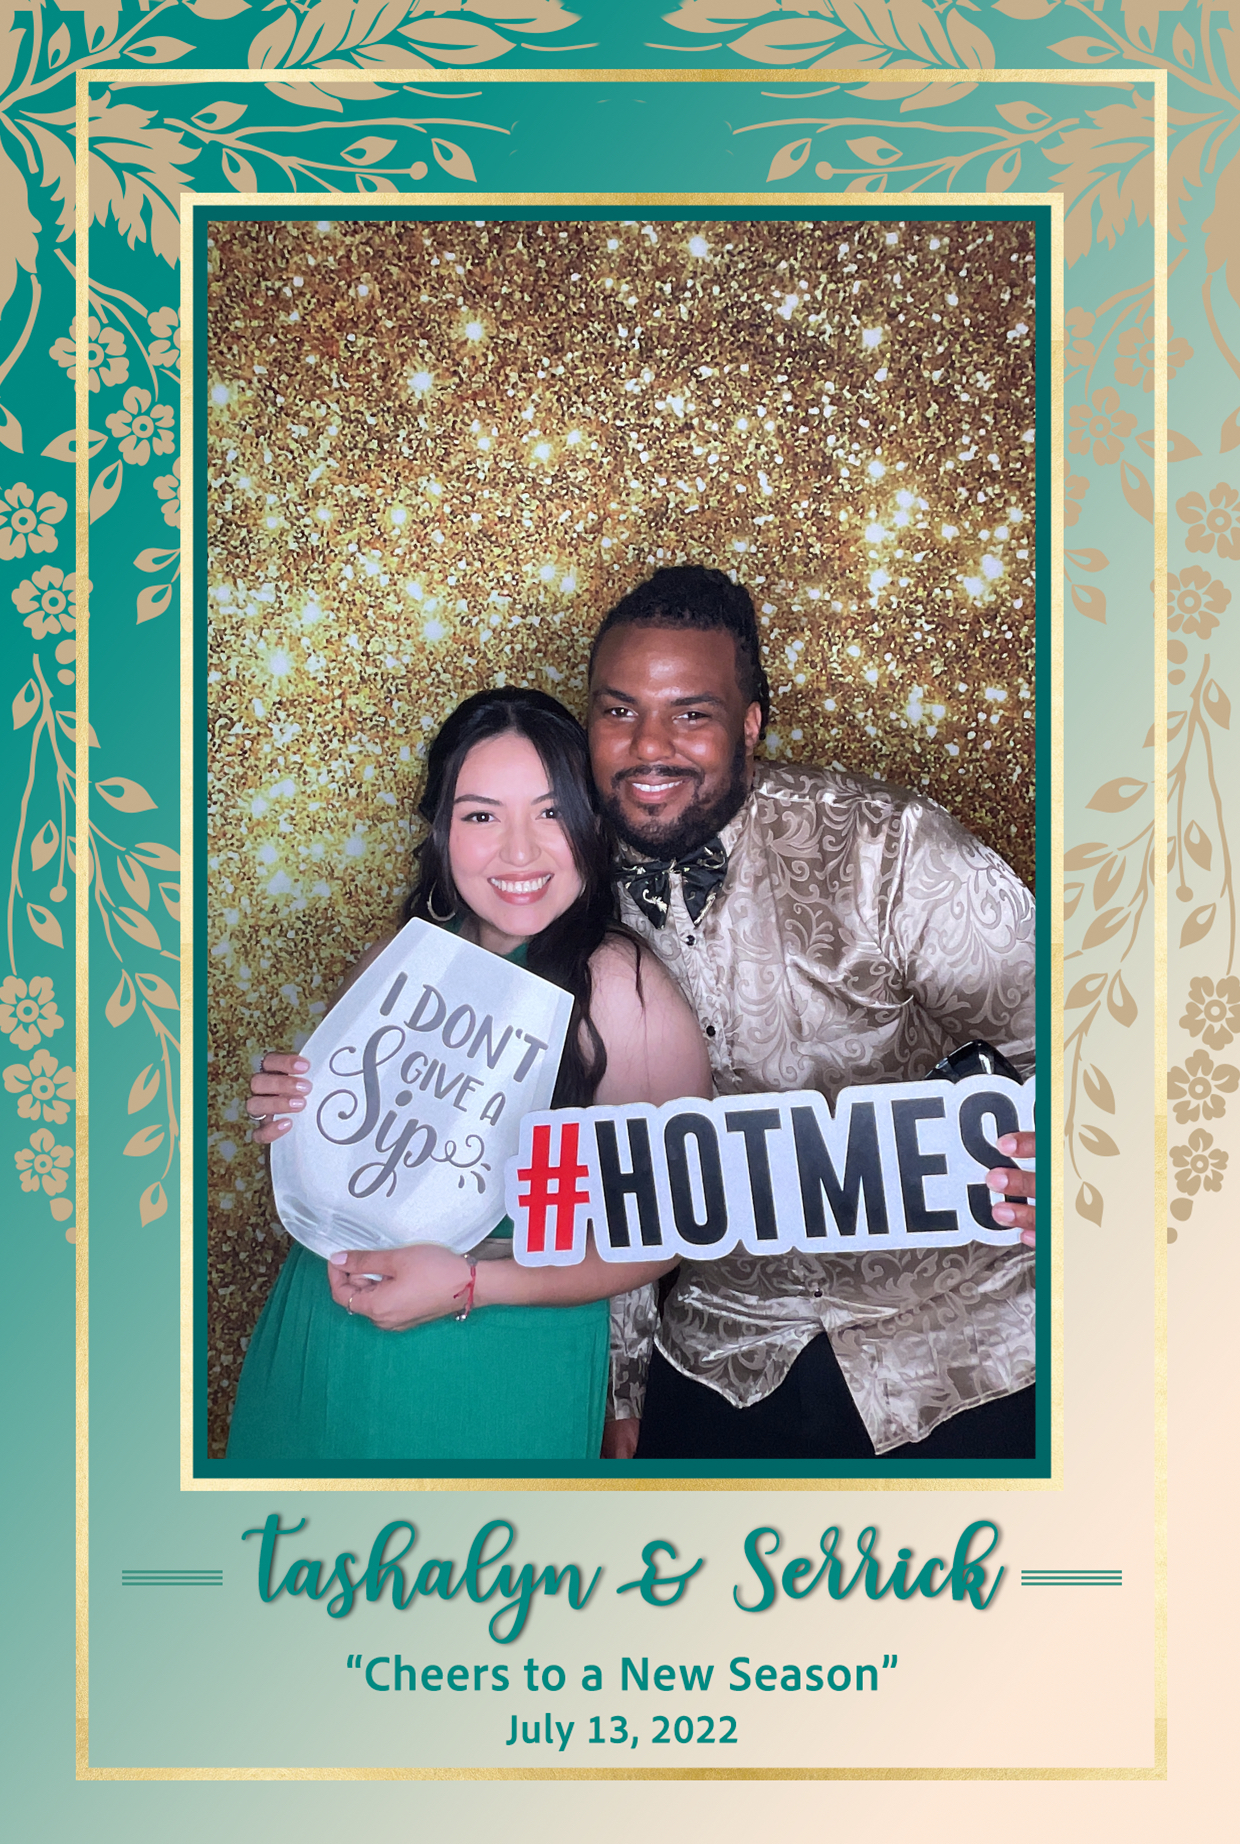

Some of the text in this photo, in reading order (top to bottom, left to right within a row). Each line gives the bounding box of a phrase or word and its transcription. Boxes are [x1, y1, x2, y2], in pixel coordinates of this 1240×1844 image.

[379, 971, 549, 1083] I DON'T
[400, 1051, 506, 1126] GIVE A
[316, 1025, 485, 1198] Sip
[517, 1090, 1036, 1254] #HOTMES
